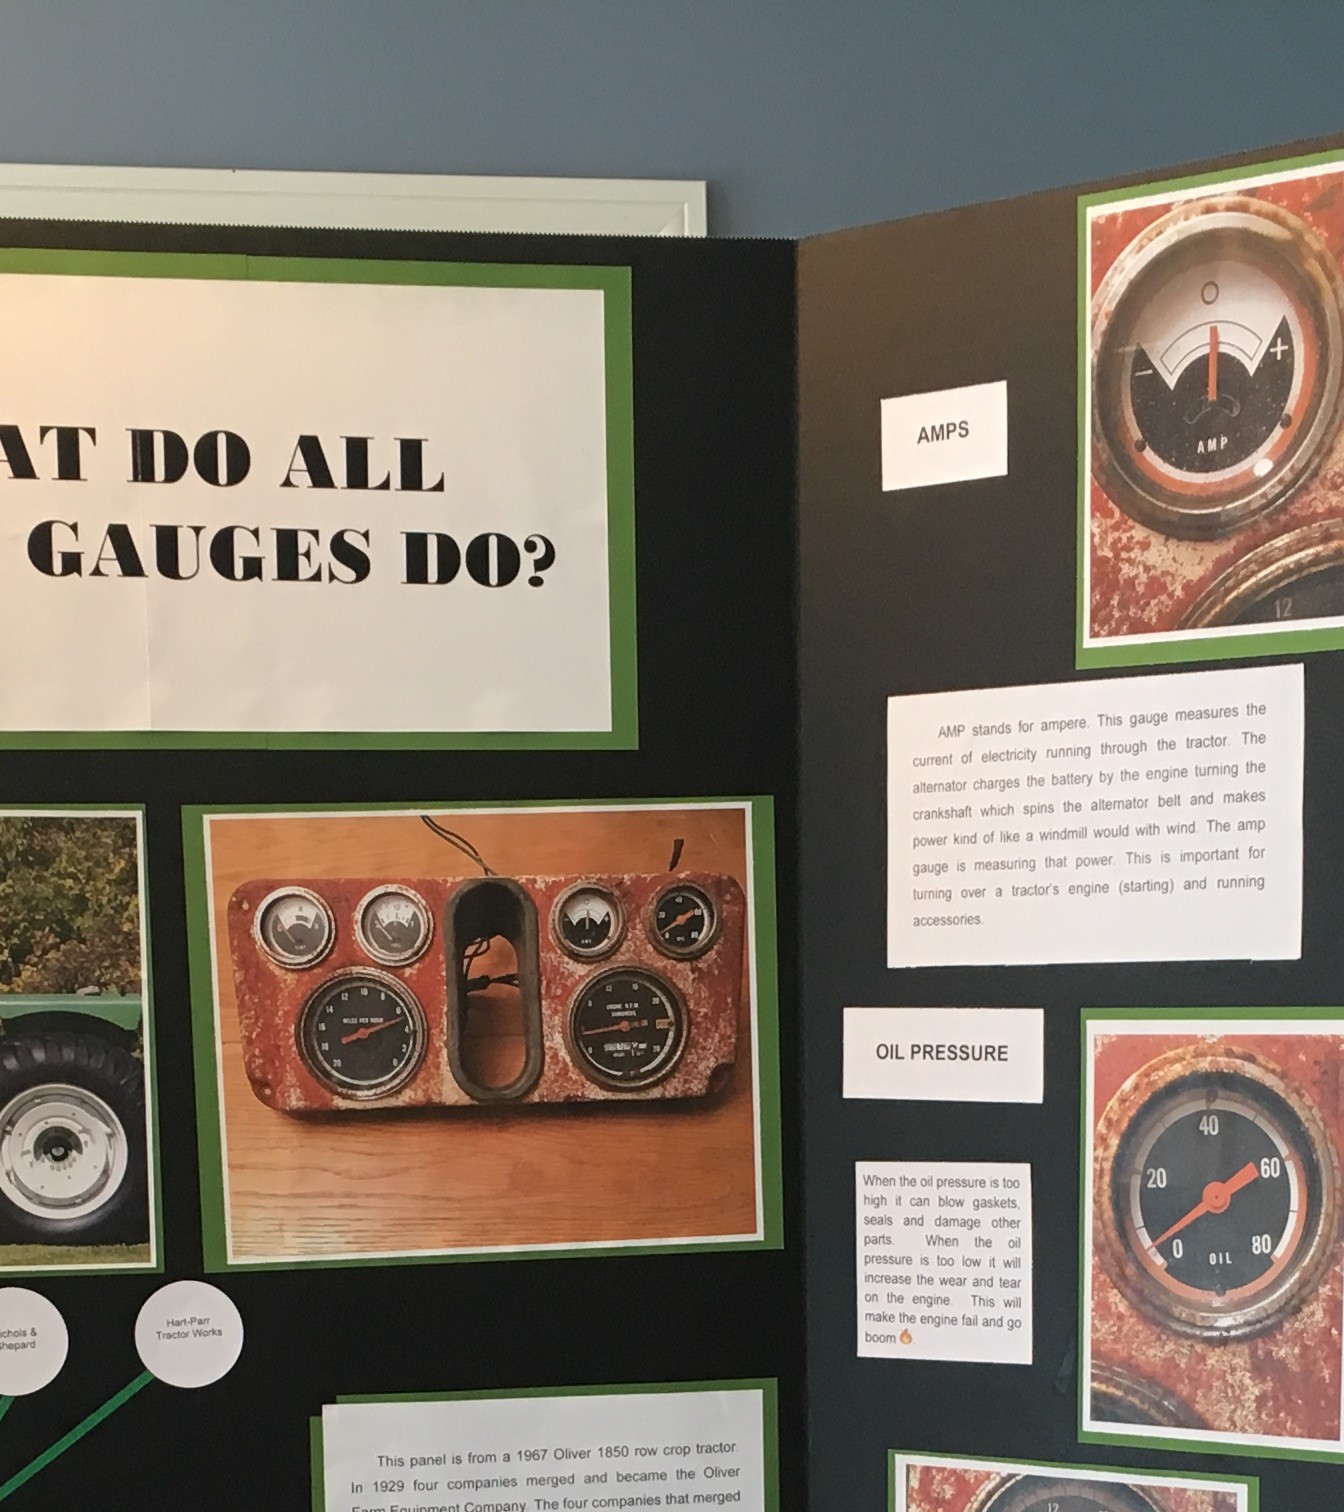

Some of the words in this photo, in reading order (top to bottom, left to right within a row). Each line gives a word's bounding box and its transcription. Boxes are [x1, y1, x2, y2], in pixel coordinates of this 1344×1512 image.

[916, 418, 970, 444] AMPS
[1197, 436, 1228, 454] AMP
[126, 428, 250, 486] DO
[279, 434, 444, 492] ALL
[27, 519, 371, 584] GAUGES
[400, 531, 556, 588] DO?
[1274, 598, 1293, 618] 12
[937, 723, 966, 739] AMP
[971, 721, 1012, 737] stands
[1017, 719, 1034, 733] for
[1040, 717, 1090, 733] ampere.
[1096, 713, 1123, 727] This
[1128, 711, 1168, 729] gauge
[1174, 706, 1239, 722] measures
[1245, 702, 1267, 716] the
[876, 1043, 906, 1061] OIL
[910, 1044, 1008, 1062] PRESSURE
[1199, 1115, 1219, 1135] 40
[1260, 1157, 1280, 1178] 60
[862, 1174, 896, 1187] When
[898, 1174, 917, 1188] the
[919, 1174, 933, 1188] oil
[936, 1177, 987, 1191] pressure
[989, 1178, 1000, 1189] is
[1002, 1176, 1020, 1189] too
[1146, 1168, 1167, 1188] 20
[1172, 1239, 1183, 1258] 0
[1252, 1234, 1272, 1254] 80
[1210, 1252, 1232, 1264] OIL
[166, 1317, 210, 1327] Hart-Parr
[30, 1328, 37, 1337] &
[156, 1330, 189, 1339] Tractor
[192, 1328, 222, 1337] Works
